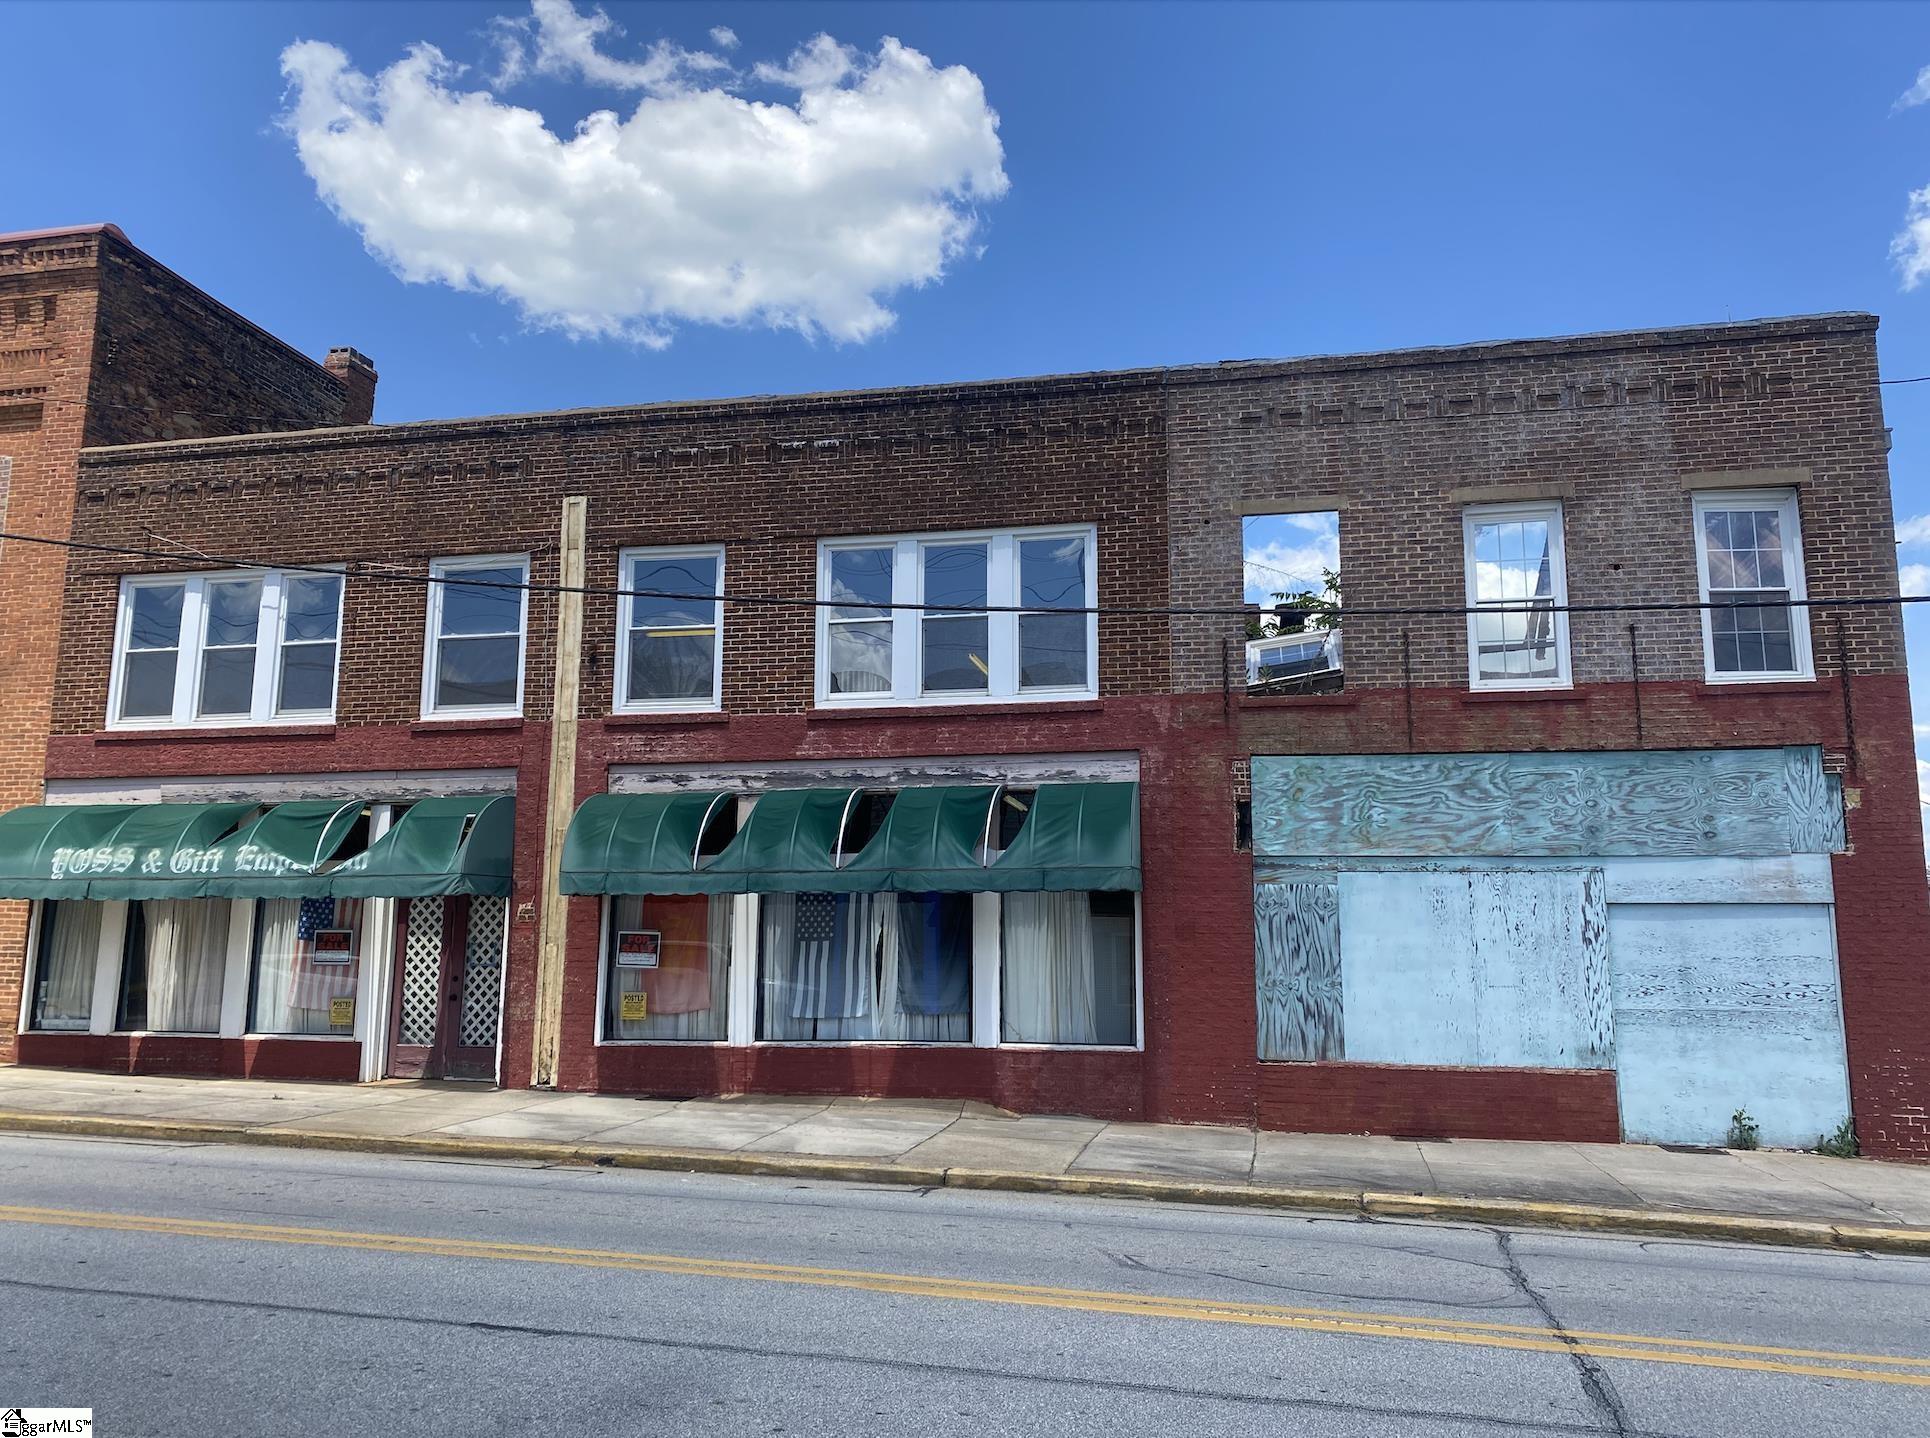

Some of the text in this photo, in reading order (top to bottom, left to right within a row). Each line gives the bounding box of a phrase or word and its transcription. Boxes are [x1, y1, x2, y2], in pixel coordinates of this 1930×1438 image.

[141, 848, 164, 873] &
[169, 848, 225, 874] Gift
[324, 934, 344, 942] FOR
[627, 935, 650, 944] FOR
[317, 942, 349, 950] SALE
[622, 944, 656, 952] SALE
[332, 1000, 352, 1008] POSTED
